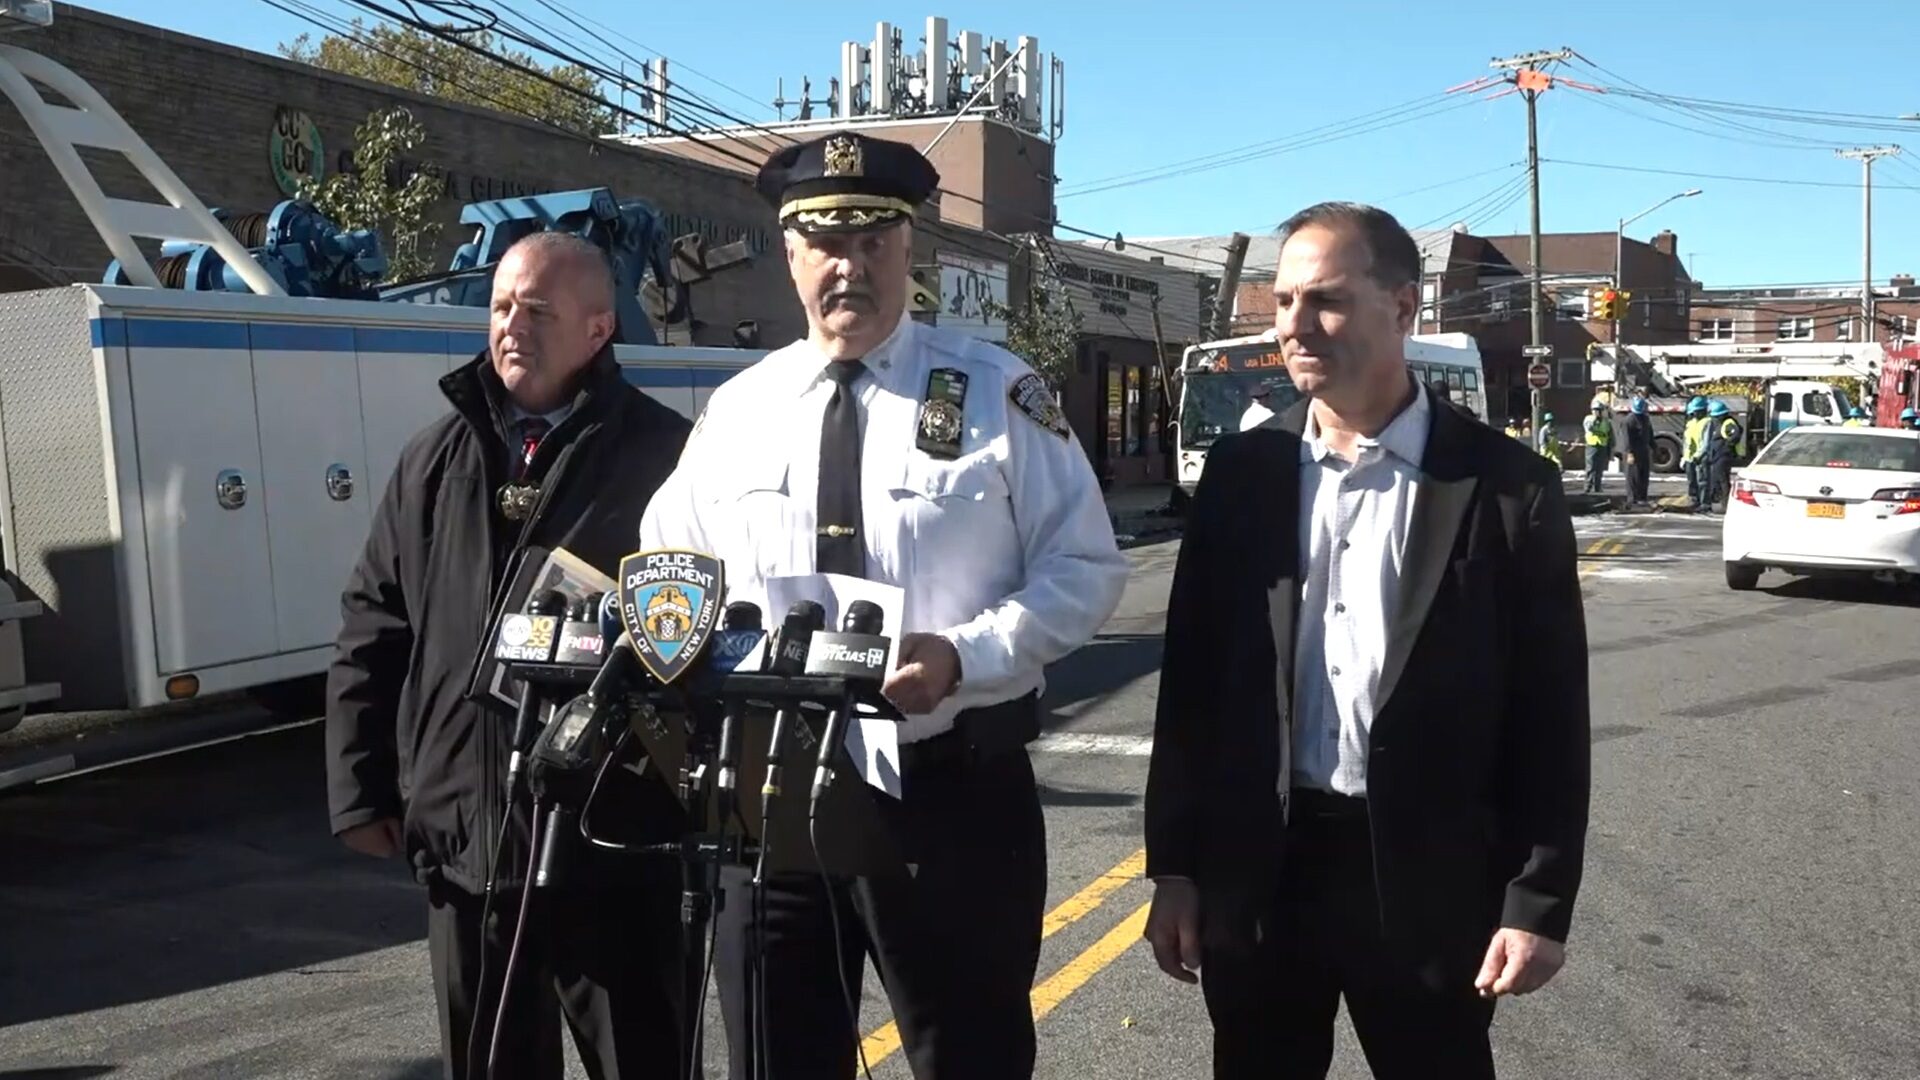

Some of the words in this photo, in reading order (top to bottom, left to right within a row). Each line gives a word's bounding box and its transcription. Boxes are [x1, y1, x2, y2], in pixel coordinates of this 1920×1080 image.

[646, 553, 695, 569] POLICE
[626, 566, 714, 590] DEPARTMENT
[532, 616, 555, 632] 10
[625, 602, 642, 635] CITY
[636, 636, 653, 655] OF
[679, 633, 702, 661] NEW
[697, 599, 715, 630] YORK
[526, 632, 552, 647] 55
[497, 645, 549, 661] NEWS
